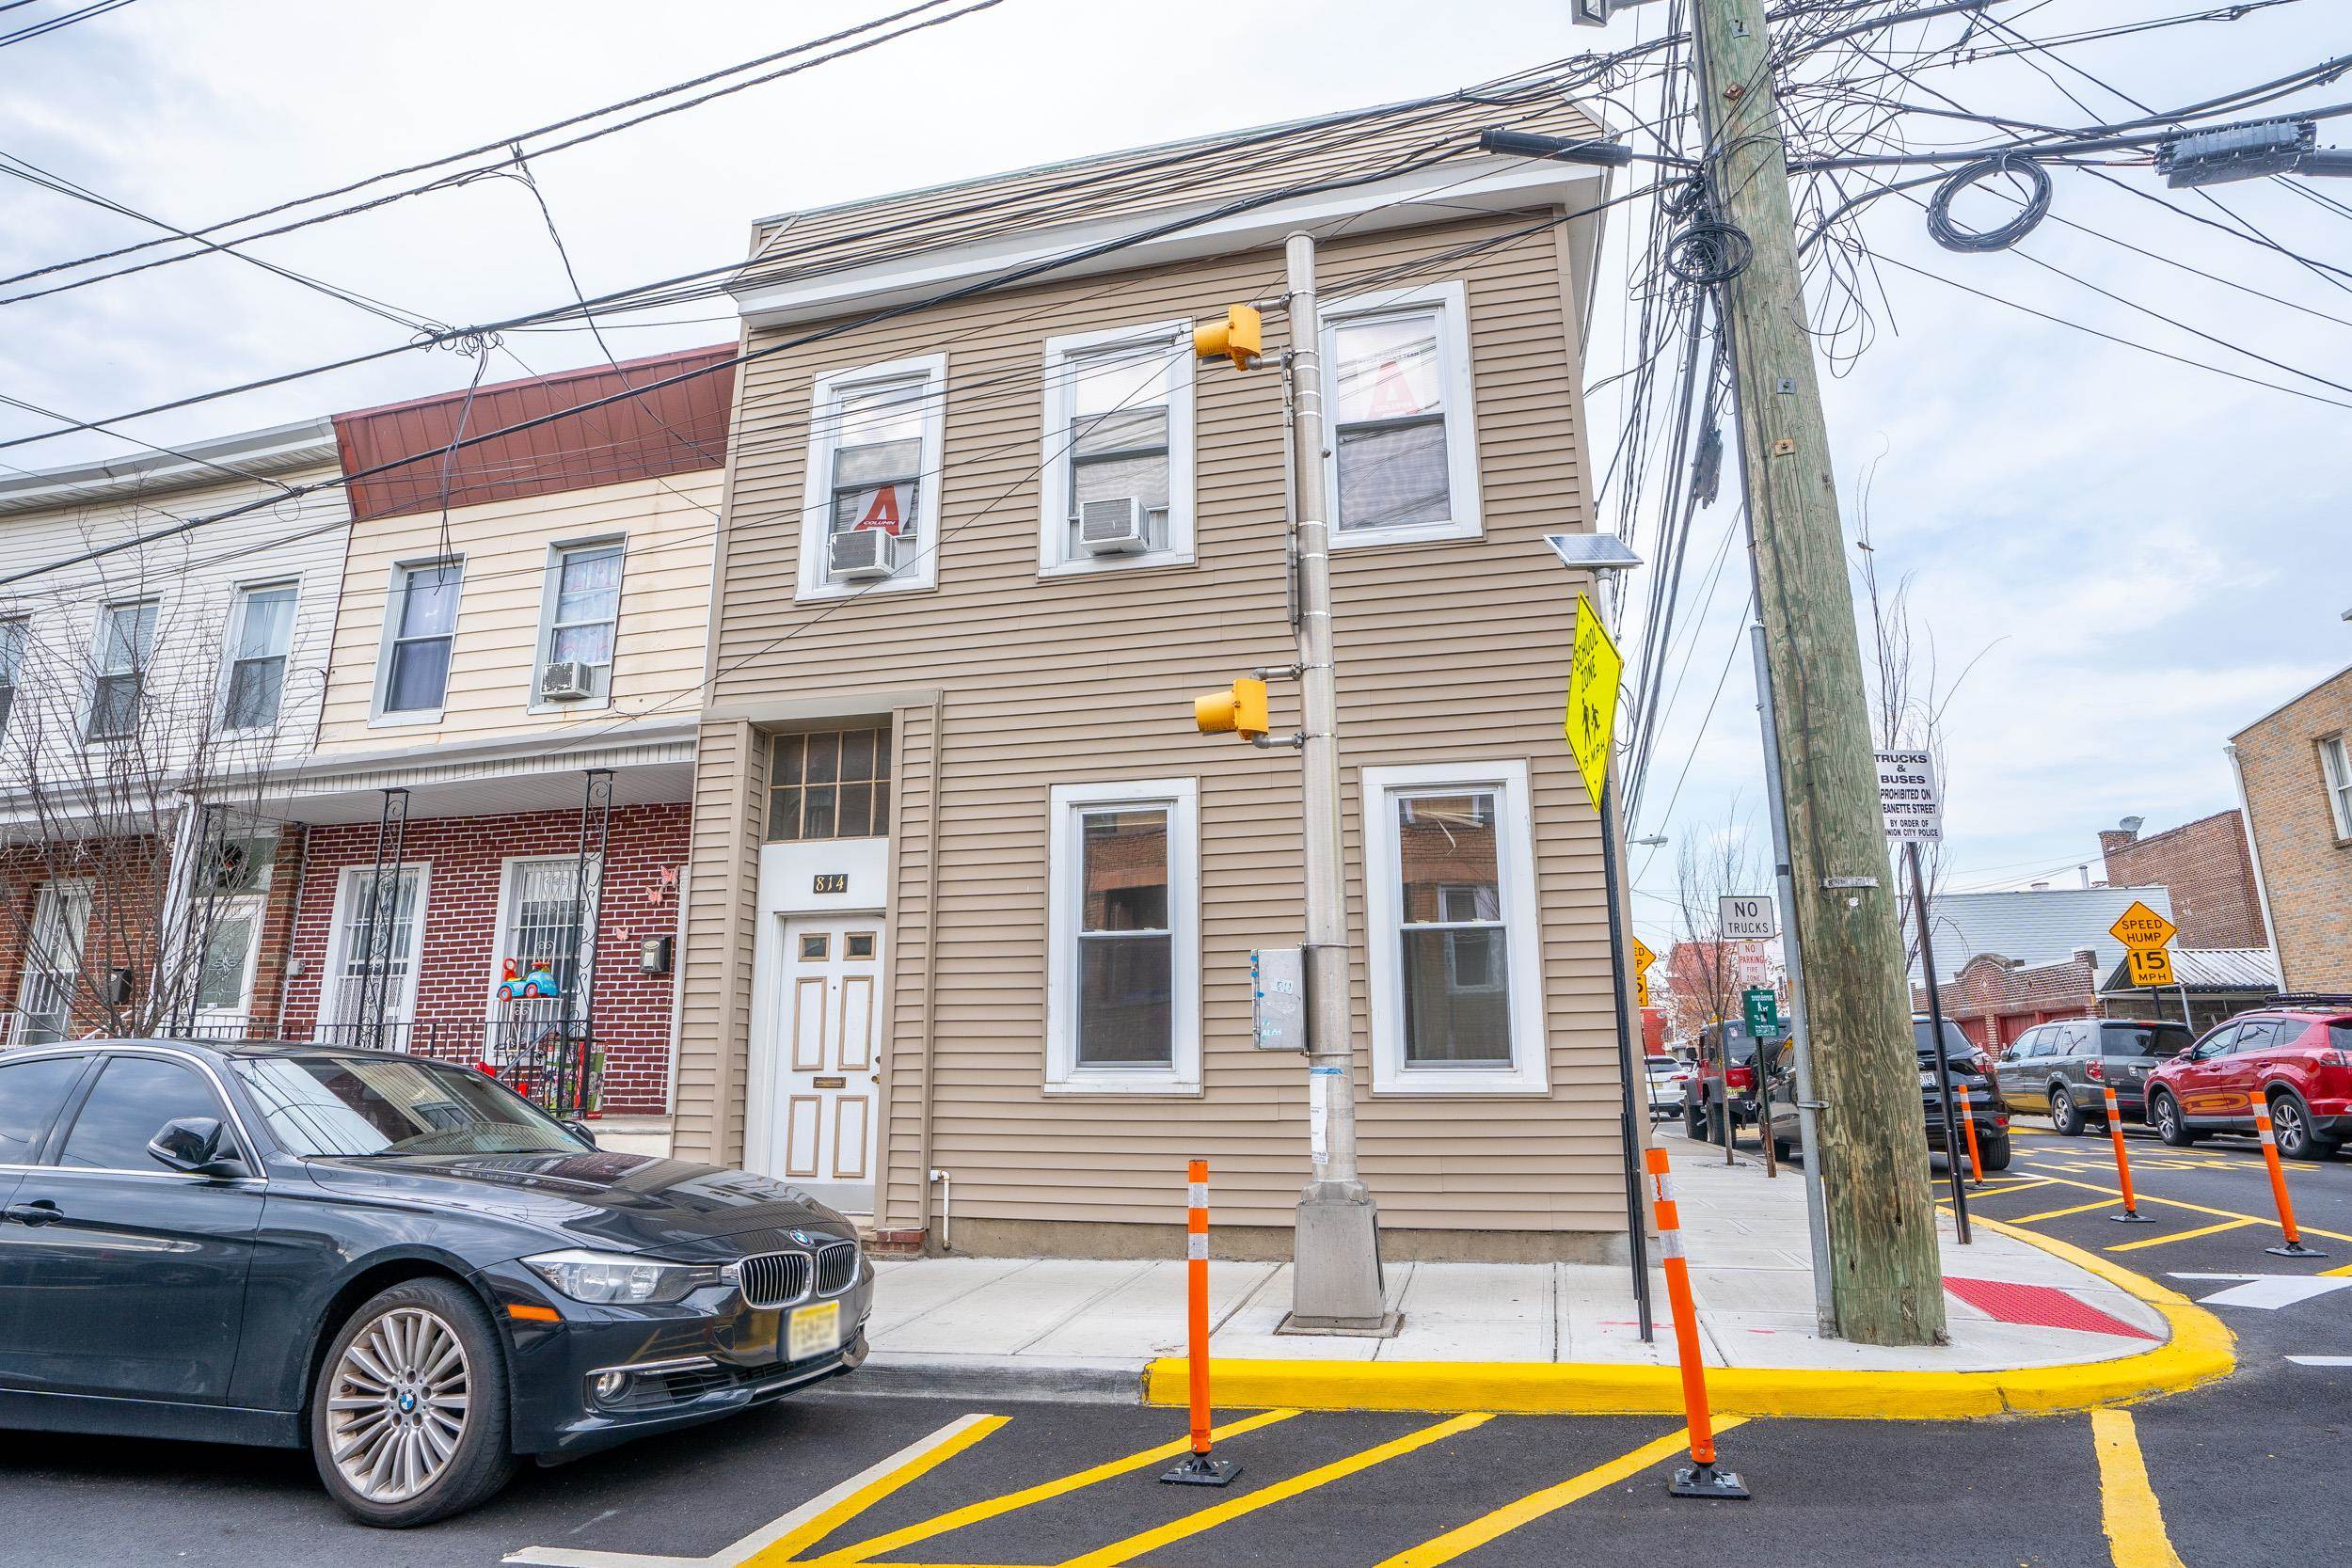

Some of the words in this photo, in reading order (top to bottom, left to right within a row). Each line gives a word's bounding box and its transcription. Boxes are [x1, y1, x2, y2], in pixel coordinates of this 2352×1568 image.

[853, 484, 900, 536] A
[1574, 625, 1598, 672] SCHOOL
[1580, 656, 1597, 693] ZONE
[1590, 737, 1606, 765] MPH
[1873, 754, 1928, 763] TRUCKS
[1897, 764, 1906, 772] &
[1881, 775, 1926, 784] BUSES
[1881, 788, 1919, 800] PROHIBITED
[1921, 789, 1931, 800] ON
[1883, 803, 1911, 814] EANETTE
[1913, 804, 1936, 814] STREET
[816, 875, 844, 892] 814
[1735, 902, 1757, 917] NO
[1728, 922, 1769, 933] TRUCKS
[2122, 920, 2162, 929] SPEED
[2127, 932, 2161, 942] HUMP
[1745, 944, 1756, 953] NO
[2133, 952, 2166, 970] 15
